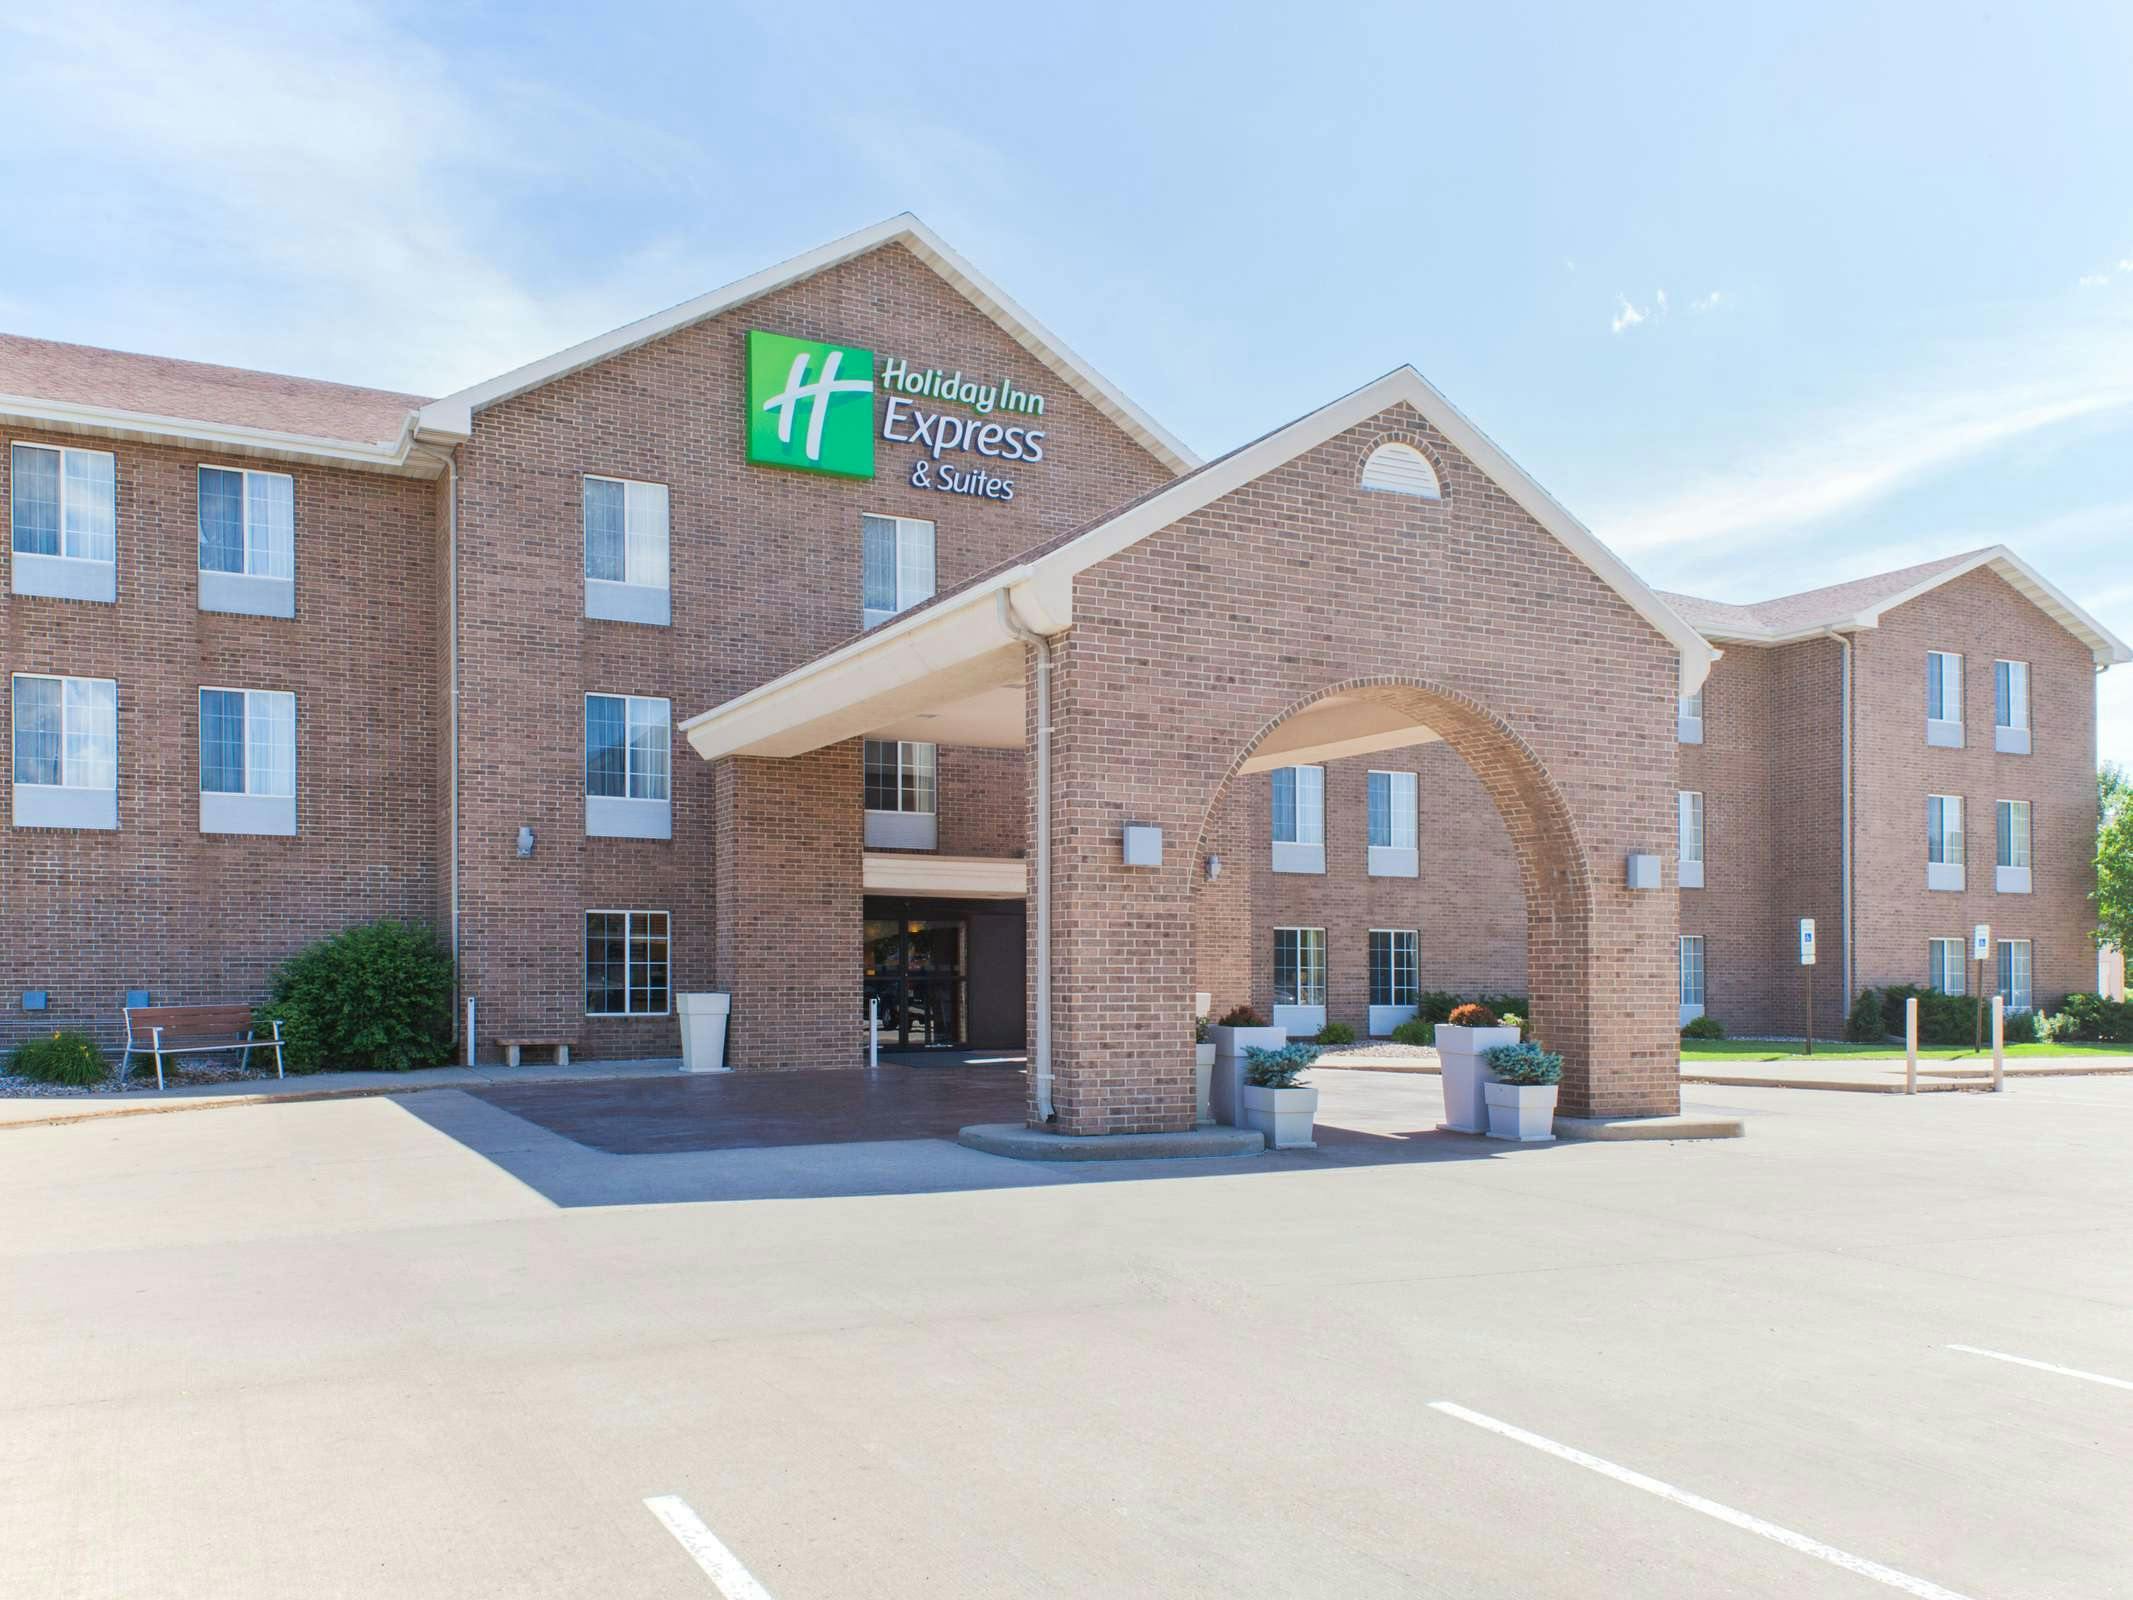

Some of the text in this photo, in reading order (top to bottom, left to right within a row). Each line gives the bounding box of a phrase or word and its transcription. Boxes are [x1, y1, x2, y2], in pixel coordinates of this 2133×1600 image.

[763, 351, 873, 460] H
[881, 357, 1045, 415] Holiday Inn
[883, 396, 1046, 462] Express
[911, 460, 1015, 500] & Suites
